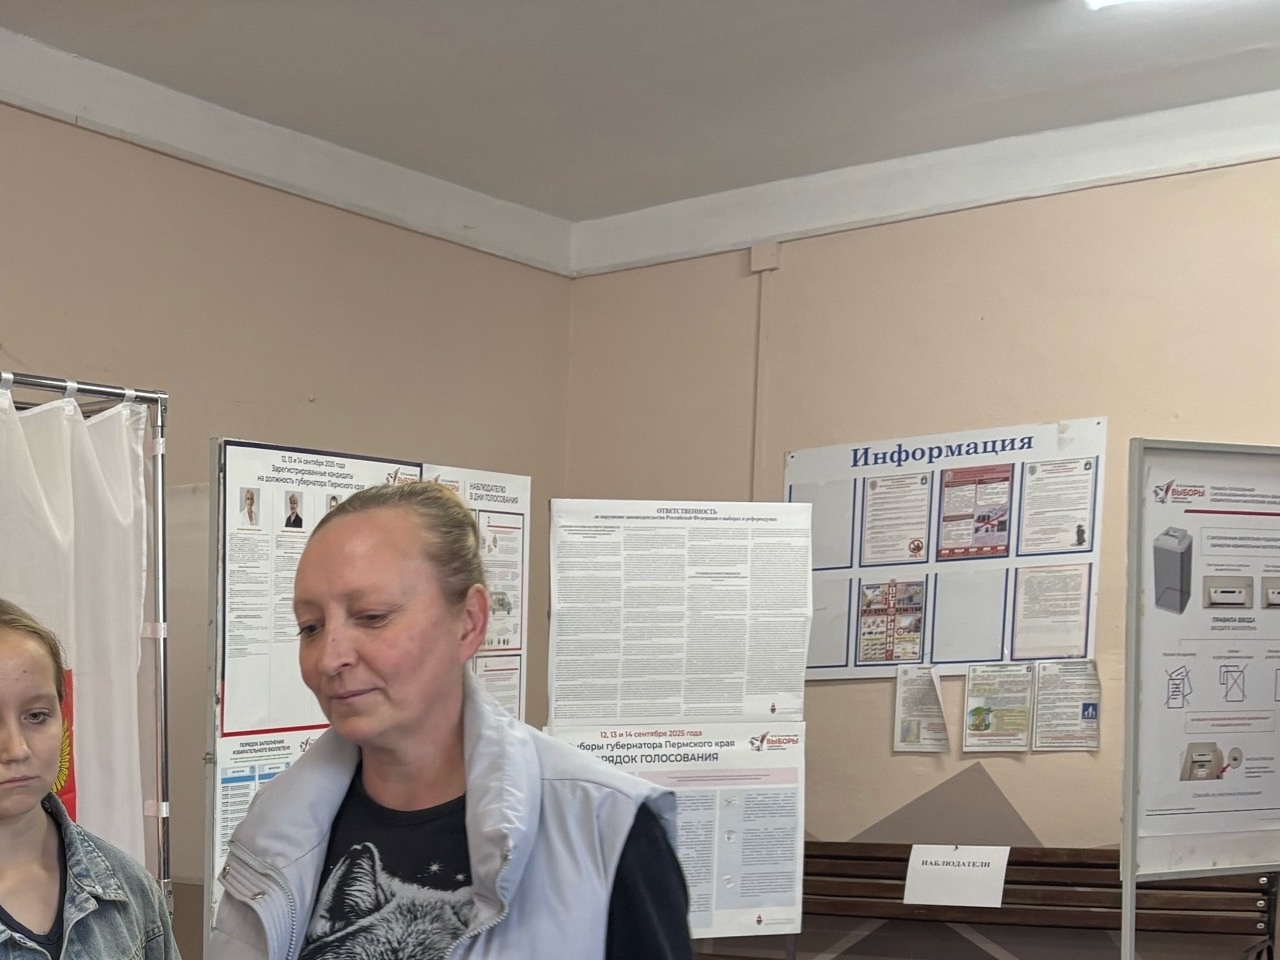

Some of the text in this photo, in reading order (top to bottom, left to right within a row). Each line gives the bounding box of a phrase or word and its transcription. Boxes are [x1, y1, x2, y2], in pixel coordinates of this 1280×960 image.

[850, 436, 1035, 467] Информация
[1171, 488, 1205, 496] ВЫБОРЫ
[656, 507, 718, 515] ОТВЕТСТВЕННОСТЬ
[577, 740, 735, 752] боры губернатора Пермского края
[600, 753, 719, 765] РЯДОК ГОЛОСОВАНИЯ
[921, 859, 991, 868] НАБЛЮДАТЕЛИ
